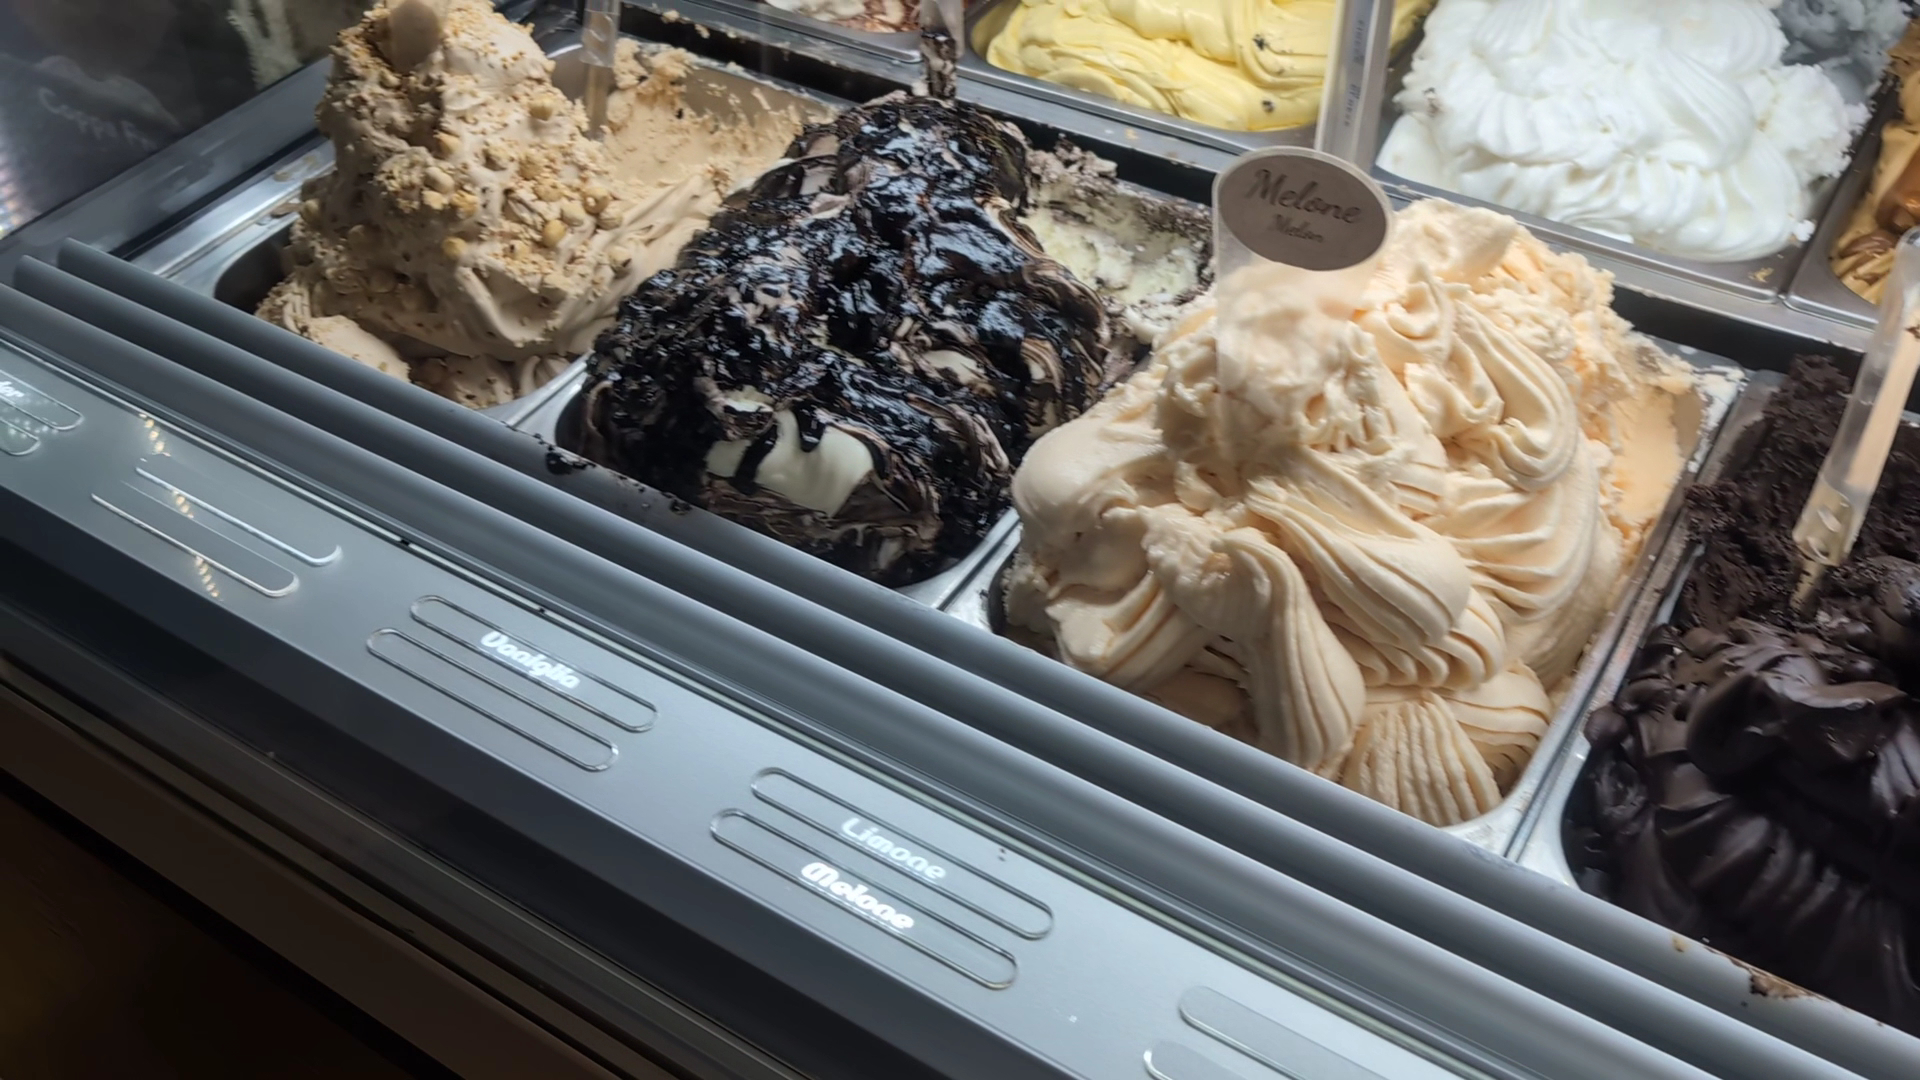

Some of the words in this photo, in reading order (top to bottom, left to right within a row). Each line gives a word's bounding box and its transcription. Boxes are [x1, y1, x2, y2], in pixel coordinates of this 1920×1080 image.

[1245, 168, 1362, 224] Melone
[841, 818, 946, 880] Limone
[800, 862, 915, 929] Melone
